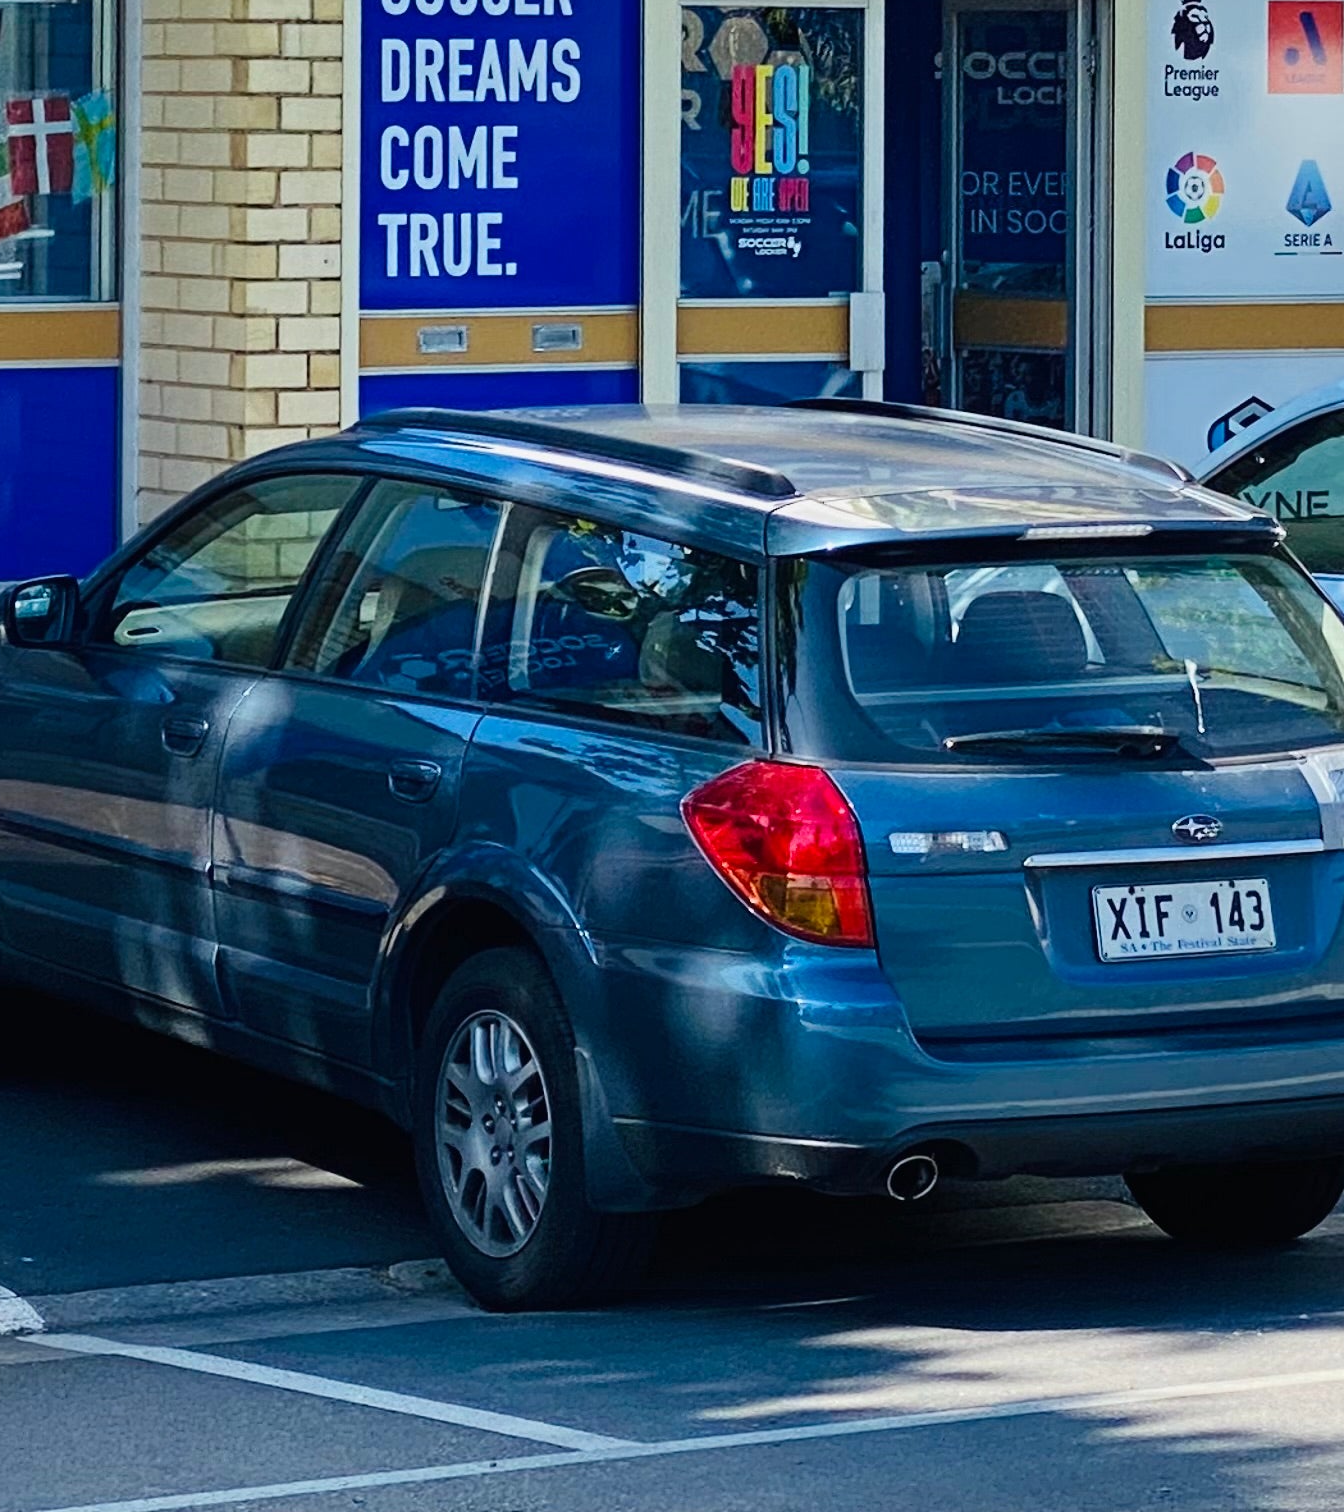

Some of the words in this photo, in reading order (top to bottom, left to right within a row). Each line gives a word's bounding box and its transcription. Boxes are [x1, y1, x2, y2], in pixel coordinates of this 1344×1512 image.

[381, 38, 581, 103] DREAMS
[1165, 64, 1219, 80] Premier
[1165, 81, 1219, 101] League
[731, 64, 810, 174] YES!
[380, 125, 518, 190] COME
[731, 177, 750, 212] WE
[753, 177, 776, 212] ARE
[971, 209, 997, 233] IN
[378, 212, 518, 277] TRUE.
[738, 238, 787, 248] SOCCER
[1165, 228, 1225, 253] LaLiga
[1284, 234, 1322, 247] SERIE
[1323, 233, 1333, 247] A
[1107, 895, 1173, 940] XIF
[1210, 891, 1264, 934] 143
[1151, 940, 1173, 951] The
[1177, 938, 1222, 950] Festival
[1224, 936, 1257, 947] State
